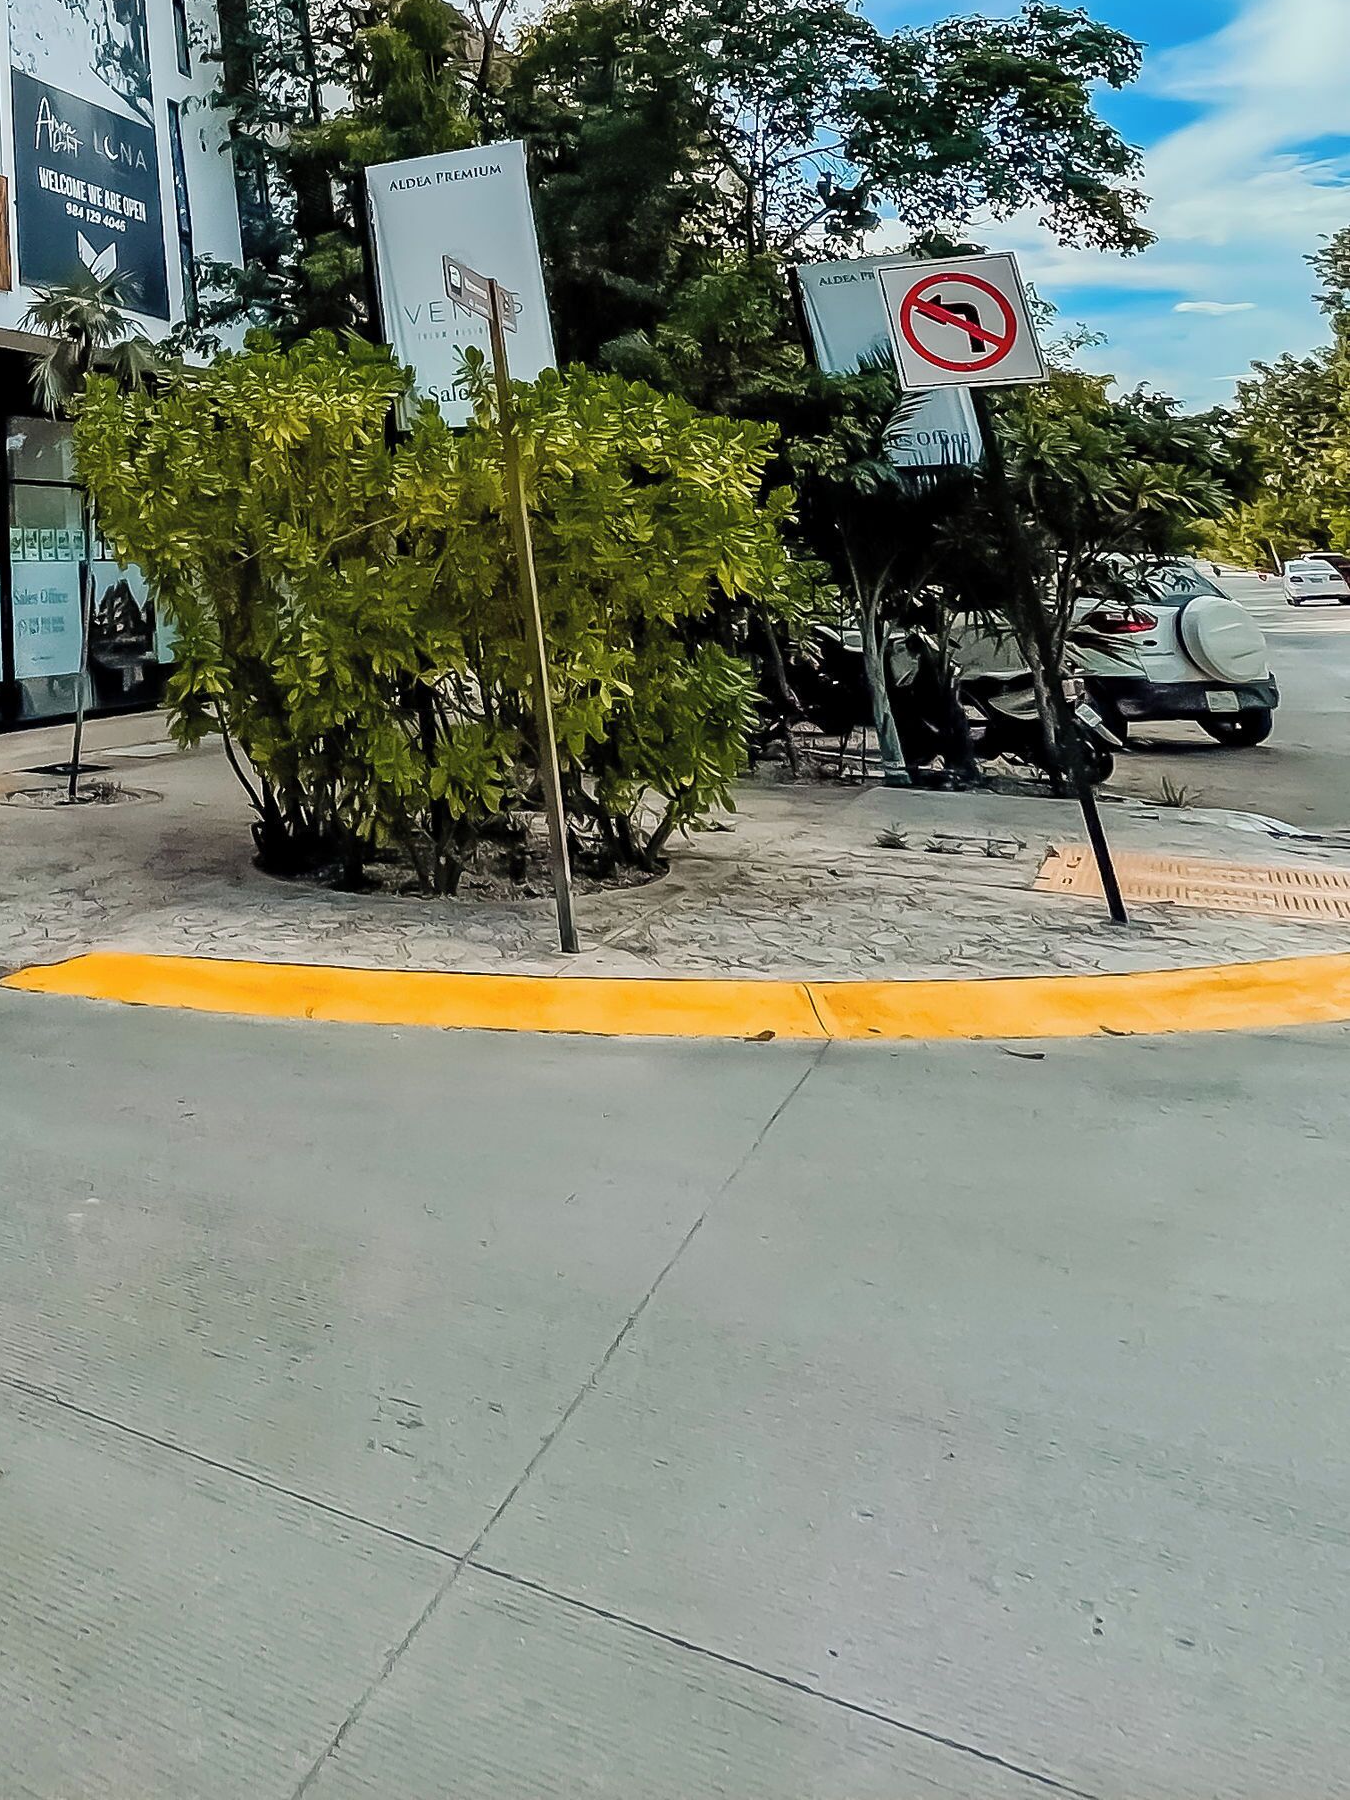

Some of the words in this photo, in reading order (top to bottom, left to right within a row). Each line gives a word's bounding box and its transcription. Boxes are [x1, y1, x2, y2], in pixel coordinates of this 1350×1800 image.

[389, 176, 432, 192] ALDEA
[435, 164, 502, 184] PREMIUM
[38, 166, 87, 202] WELCOME
[87, 183, 104, 207] WE
[104, 189, 123, 215] ARE
[123, 196, 147, 223] OPEN
[65, 202, 84, 219] 984
[819, 274, 858, 287] ALDEA
[403, 292, 524, 325] VENS
[428, 384, 471, 402] Sale
[13, 587, 38, 606] Sales
[40, 587, 69, 604] Office
